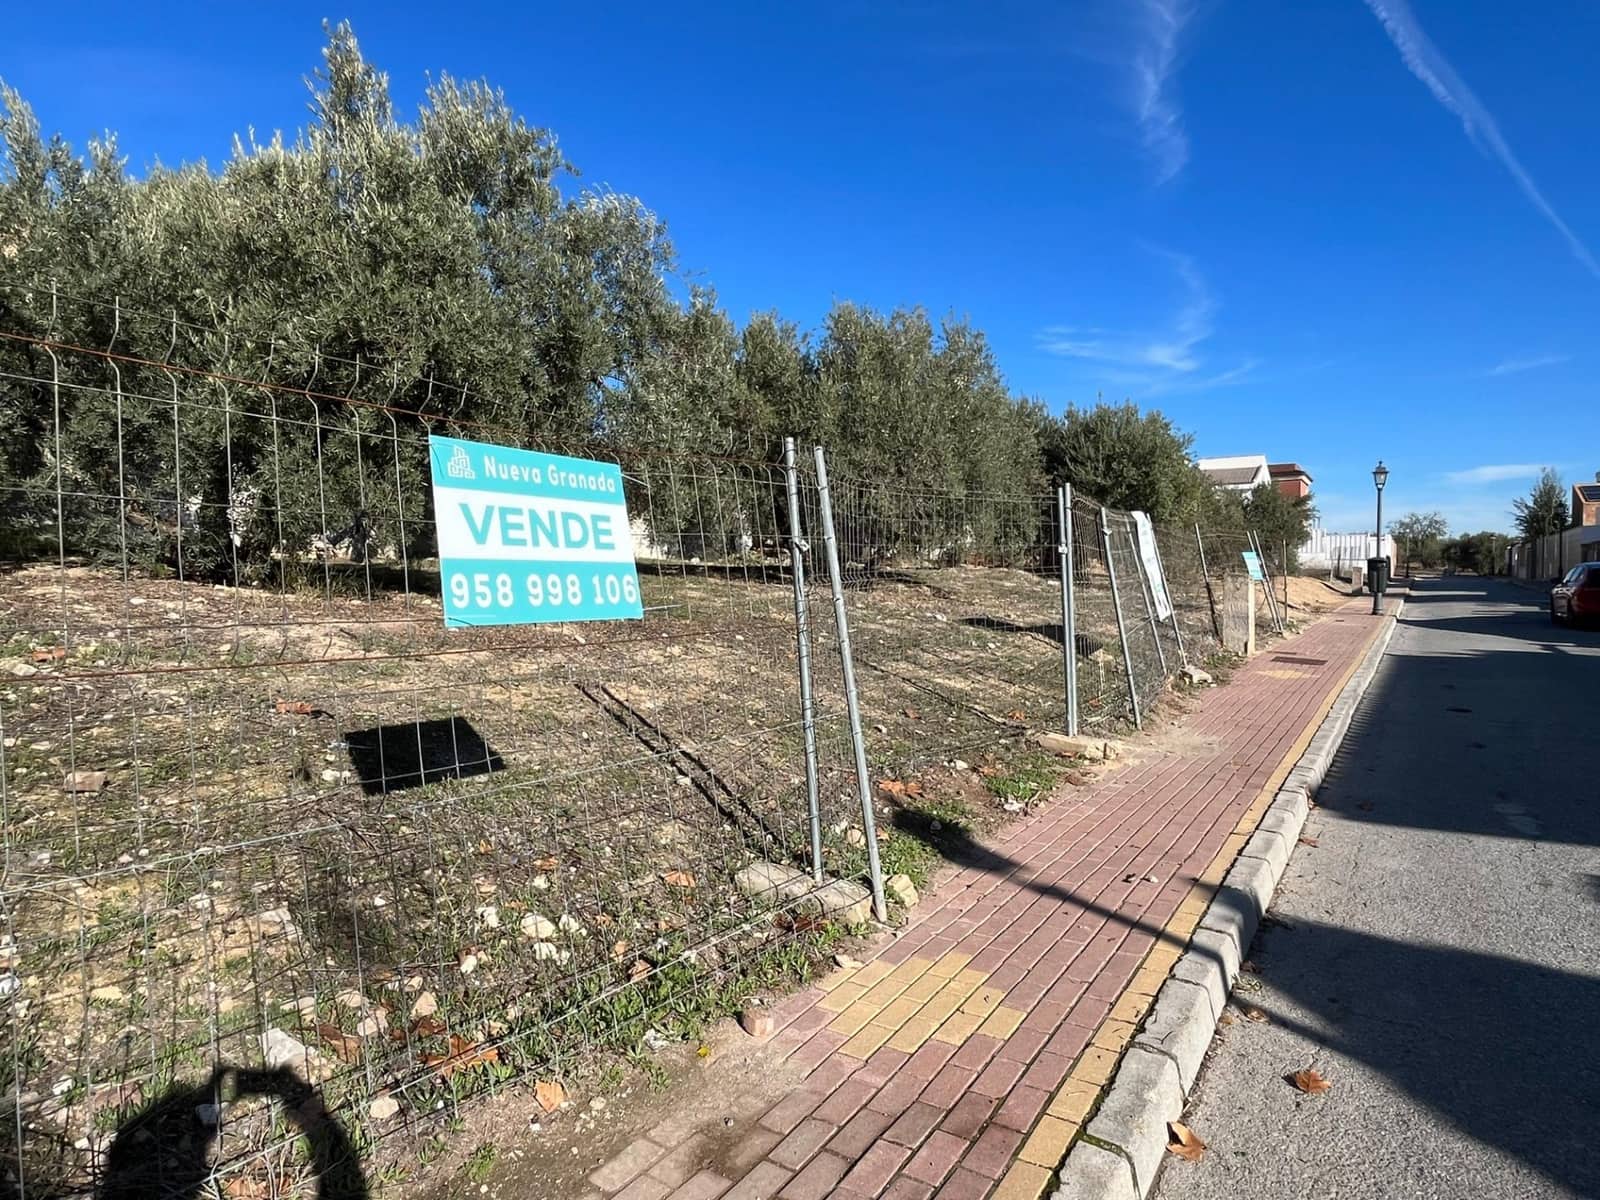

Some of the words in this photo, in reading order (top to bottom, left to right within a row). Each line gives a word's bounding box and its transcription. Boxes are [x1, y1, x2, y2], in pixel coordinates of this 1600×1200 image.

[484, 455, 541, 484] Nueva
[547, 464, 616, 493] Granada
[458, 503, 616, 550] VENDE
[450, 572, 513, 608] 958
[526, 573, 582, 606] 998
[592, 574, 637, 605] 106
